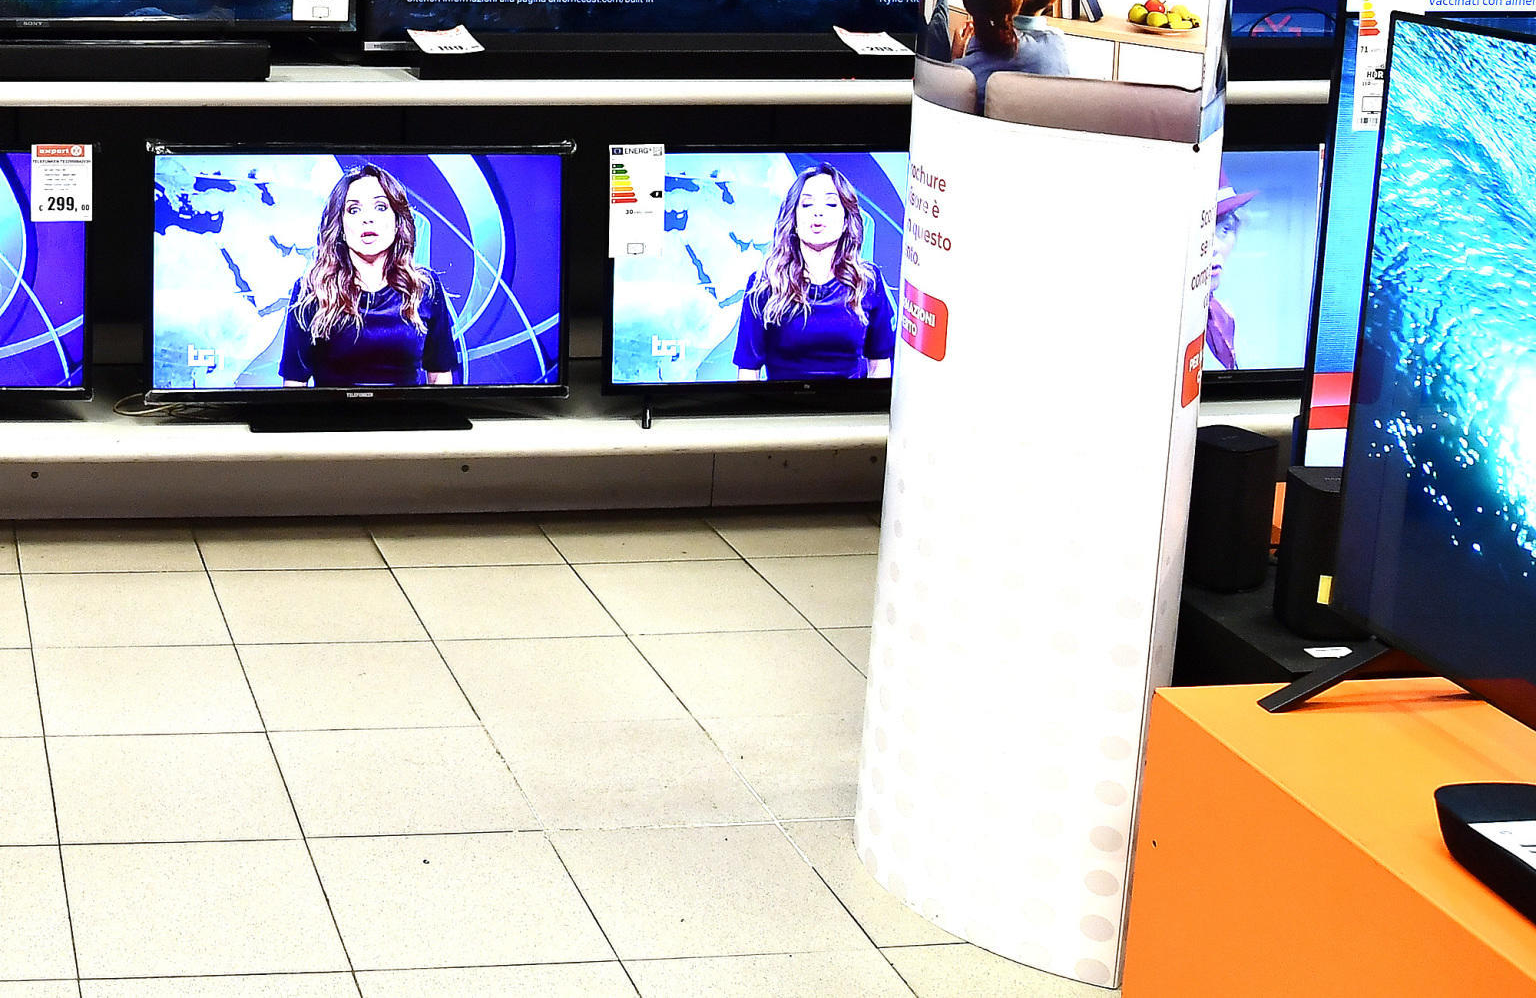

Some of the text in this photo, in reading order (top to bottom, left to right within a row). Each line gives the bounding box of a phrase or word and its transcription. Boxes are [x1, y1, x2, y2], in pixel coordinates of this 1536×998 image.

[624, 147, 649, 155] ENERG
[931, 199, 940, 218] è
[912, 222, 952, 252] questo
